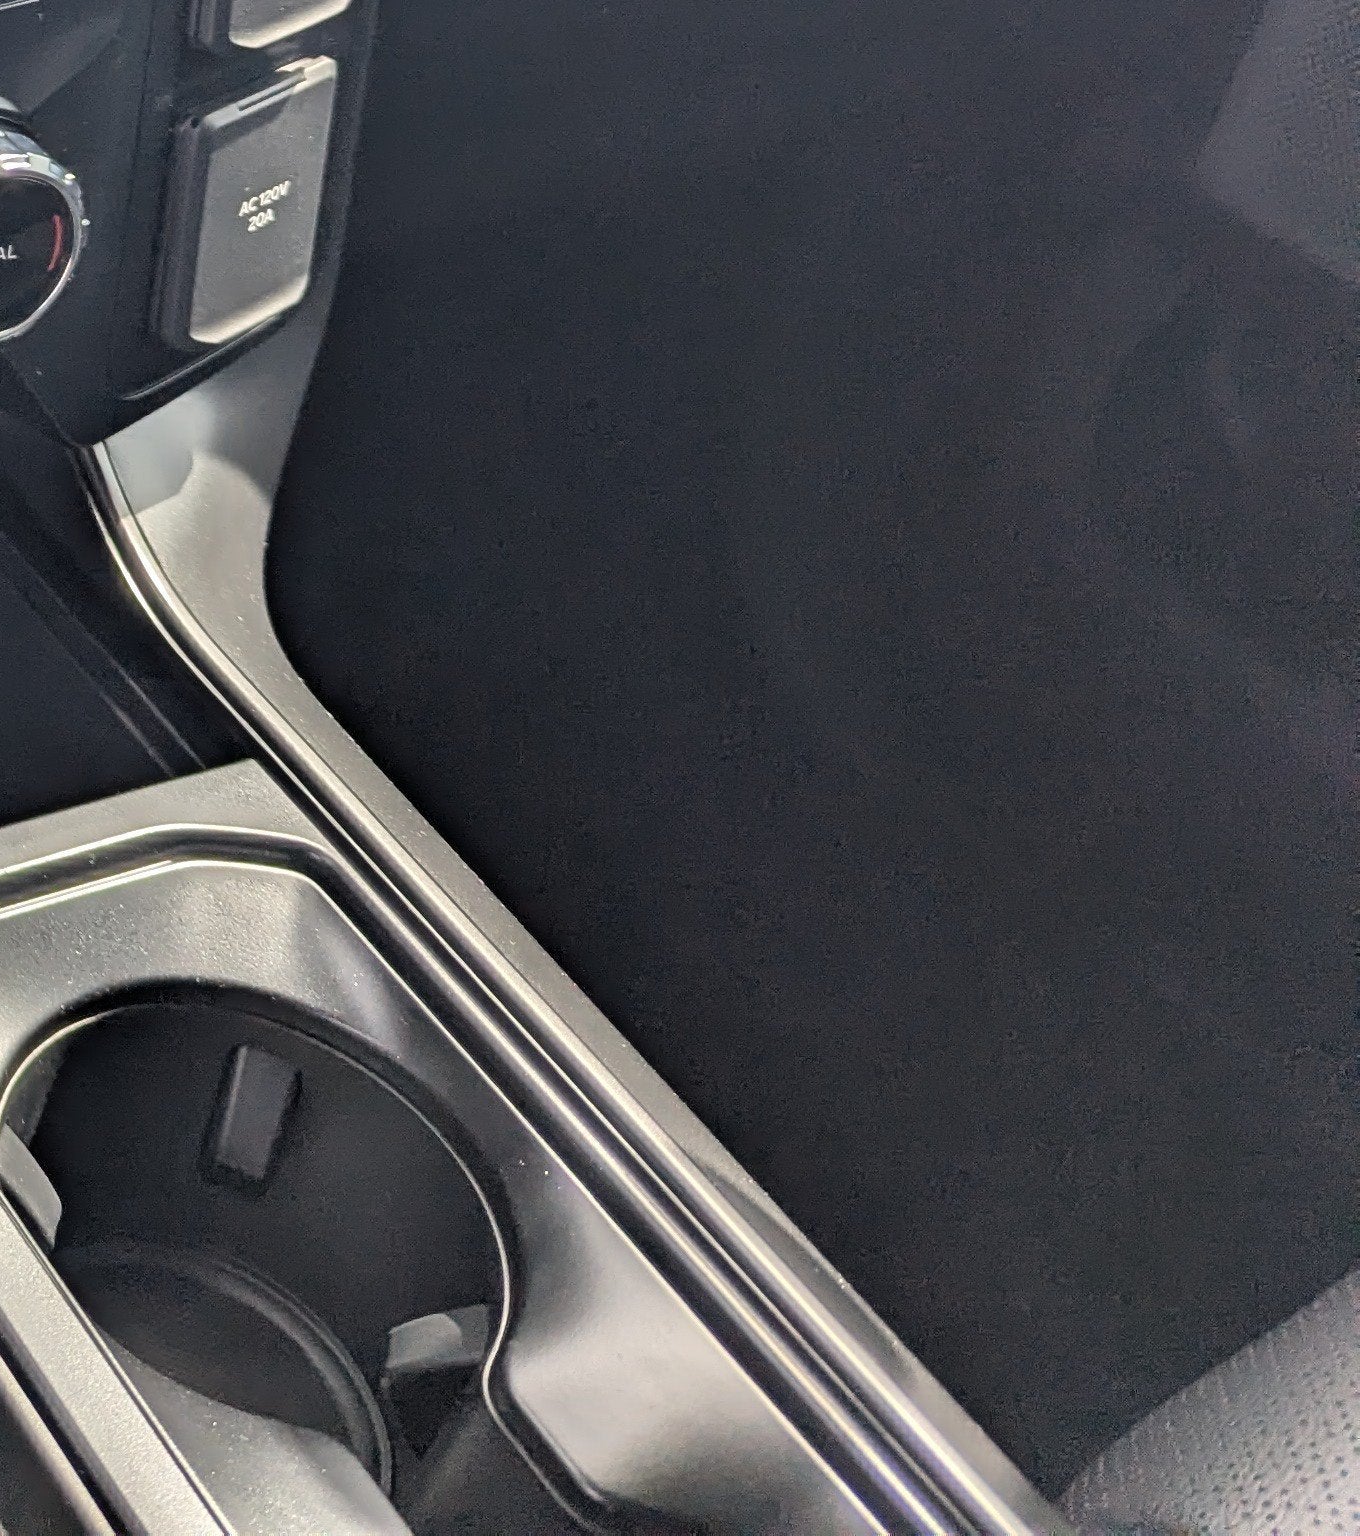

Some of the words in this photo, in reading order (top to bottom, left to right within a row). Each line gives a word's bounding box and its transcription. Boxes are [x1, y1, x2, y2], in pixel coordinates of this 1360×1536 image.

[239, 196, 259, 216] AC
[259, 180, 291, 206] 120V
[247, 208, 275, 232] 20A
